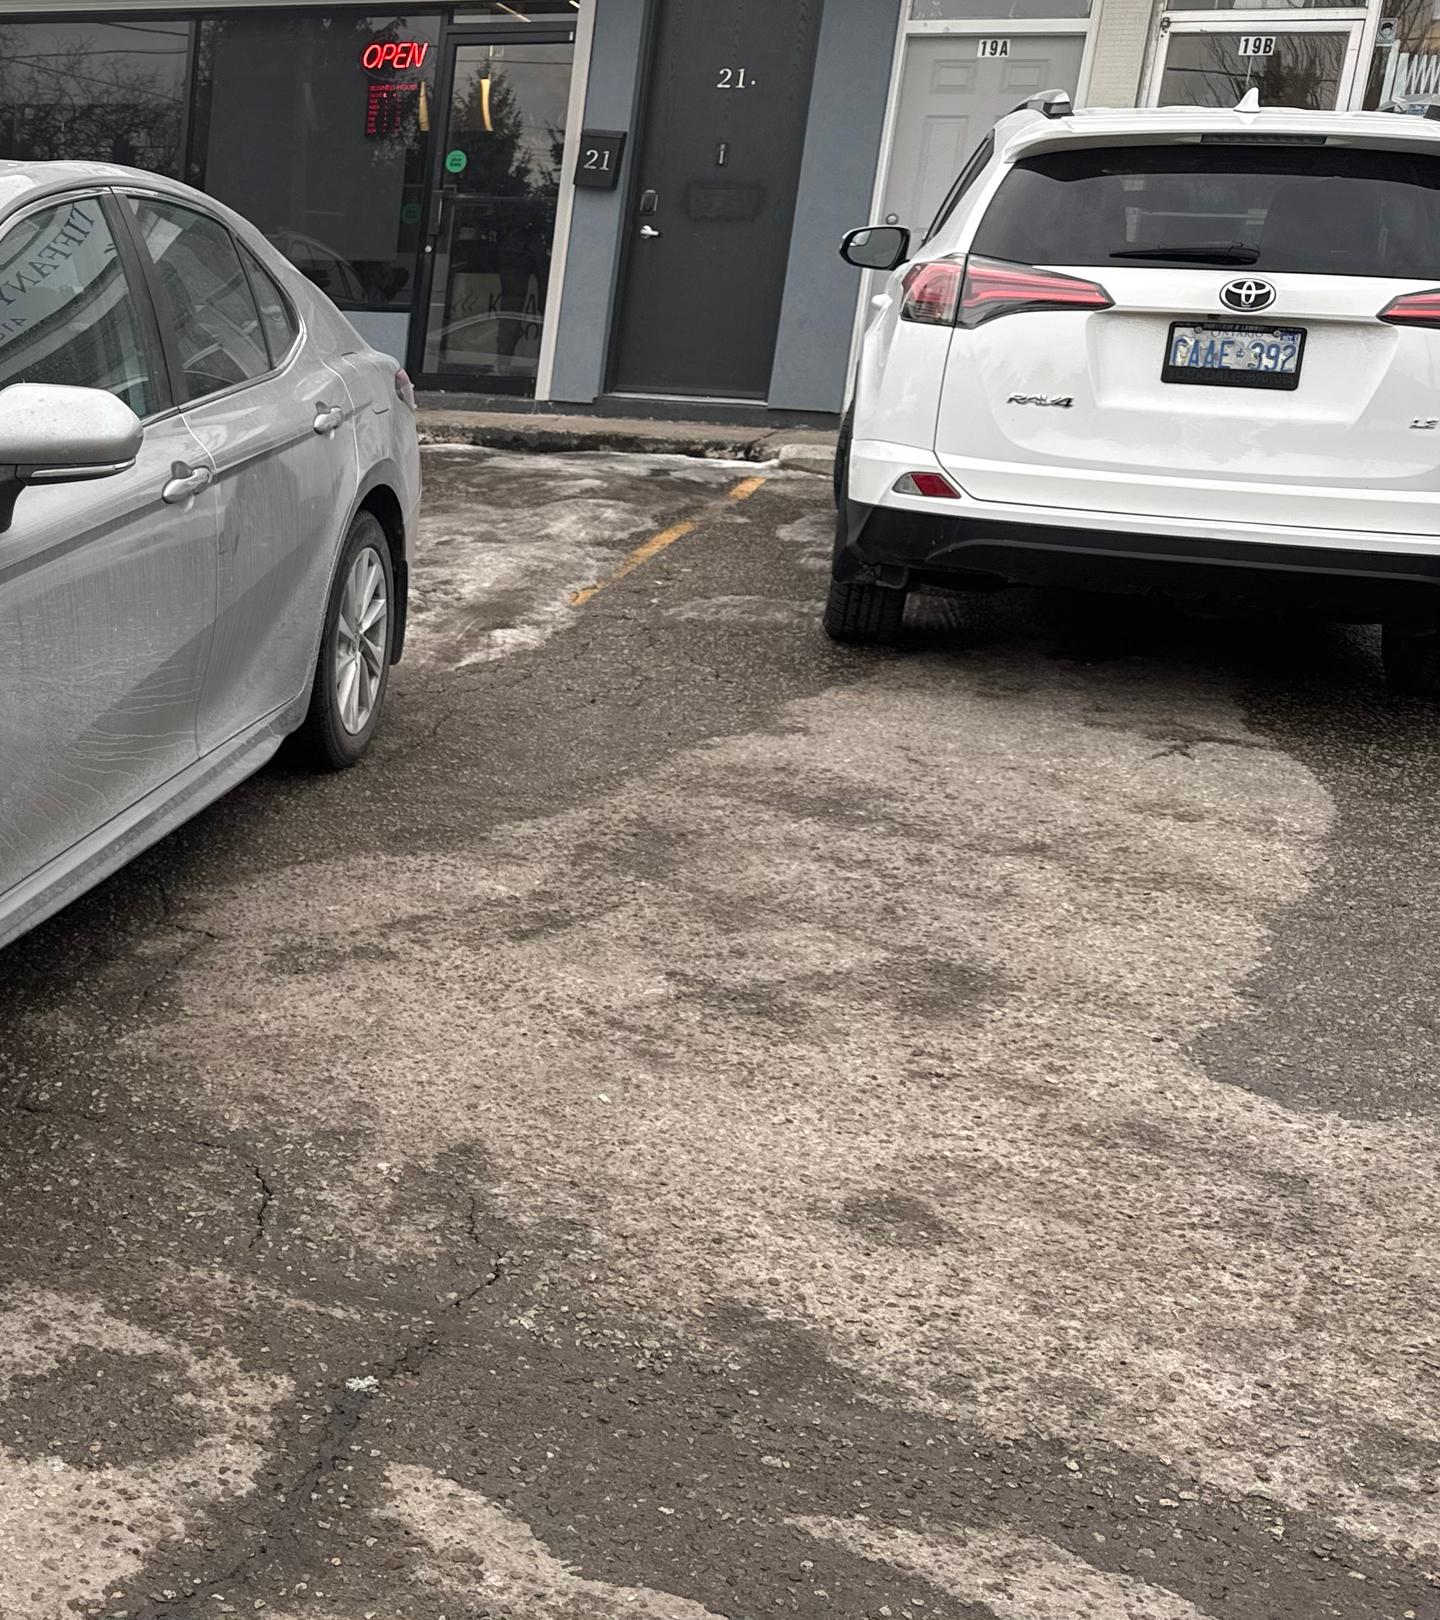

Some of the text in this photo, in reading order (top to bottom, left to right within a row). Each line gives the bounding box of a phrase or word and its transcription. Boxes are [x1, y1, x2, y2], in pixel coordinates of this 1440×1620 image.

[363, 42, 429, 69] OPEN
[980, 40, 1009, 57] 19A
[1242, 37, 1273, 55] 19B
[583, 150, 611, 171] 21
[1248, 342, 1297, 373] 392
[1006, 393, 1075, 409] RAV4
